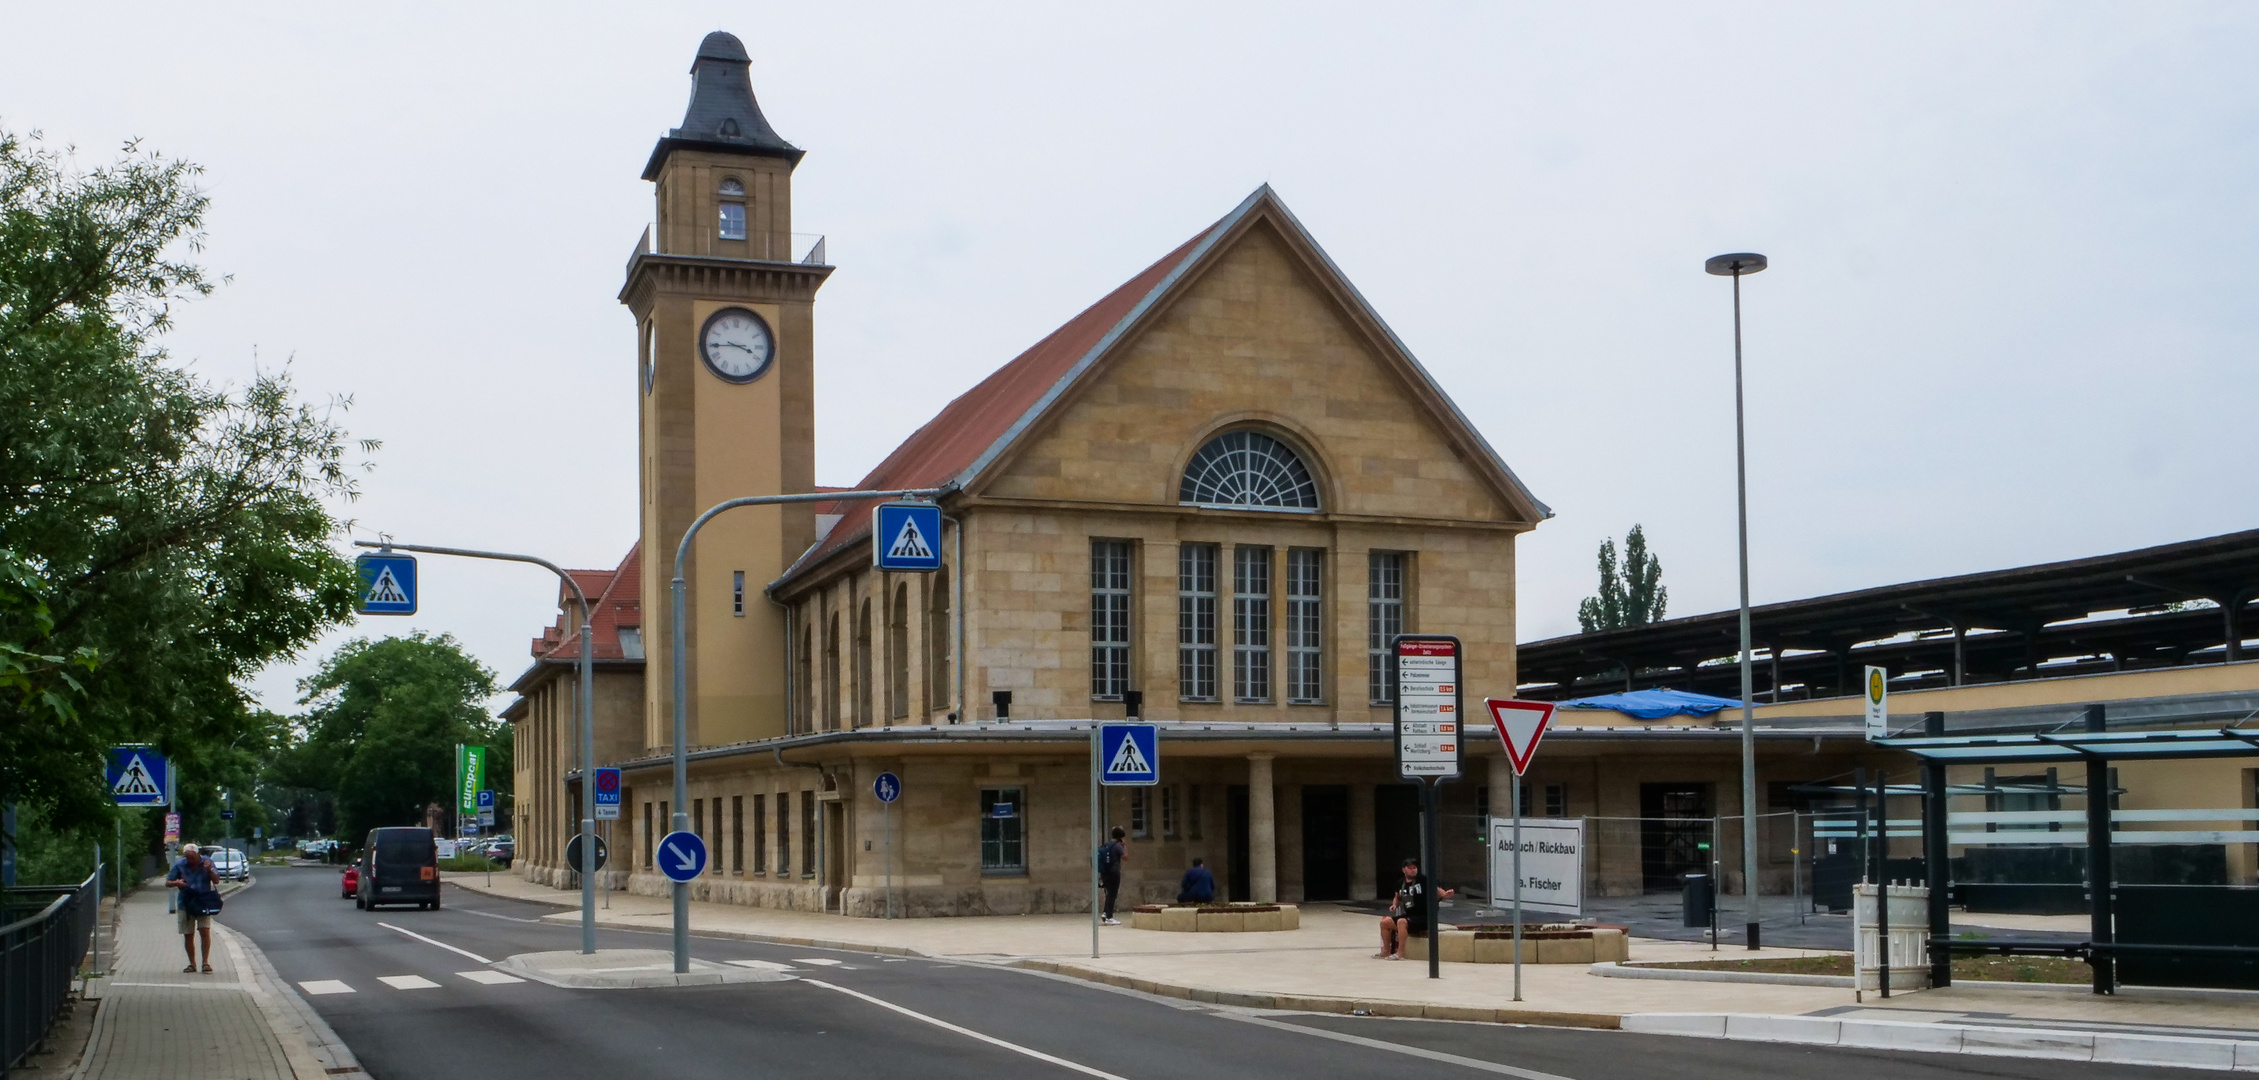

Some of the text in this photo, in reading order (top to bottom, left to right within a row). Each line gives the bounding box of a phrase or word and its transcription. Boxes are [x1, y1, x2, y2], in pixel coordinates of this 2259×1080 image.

[479, 792, 490, 805] P
[597, 793, 618, 802] TAXI
[1529, 877, 1562, 891] Fischer
